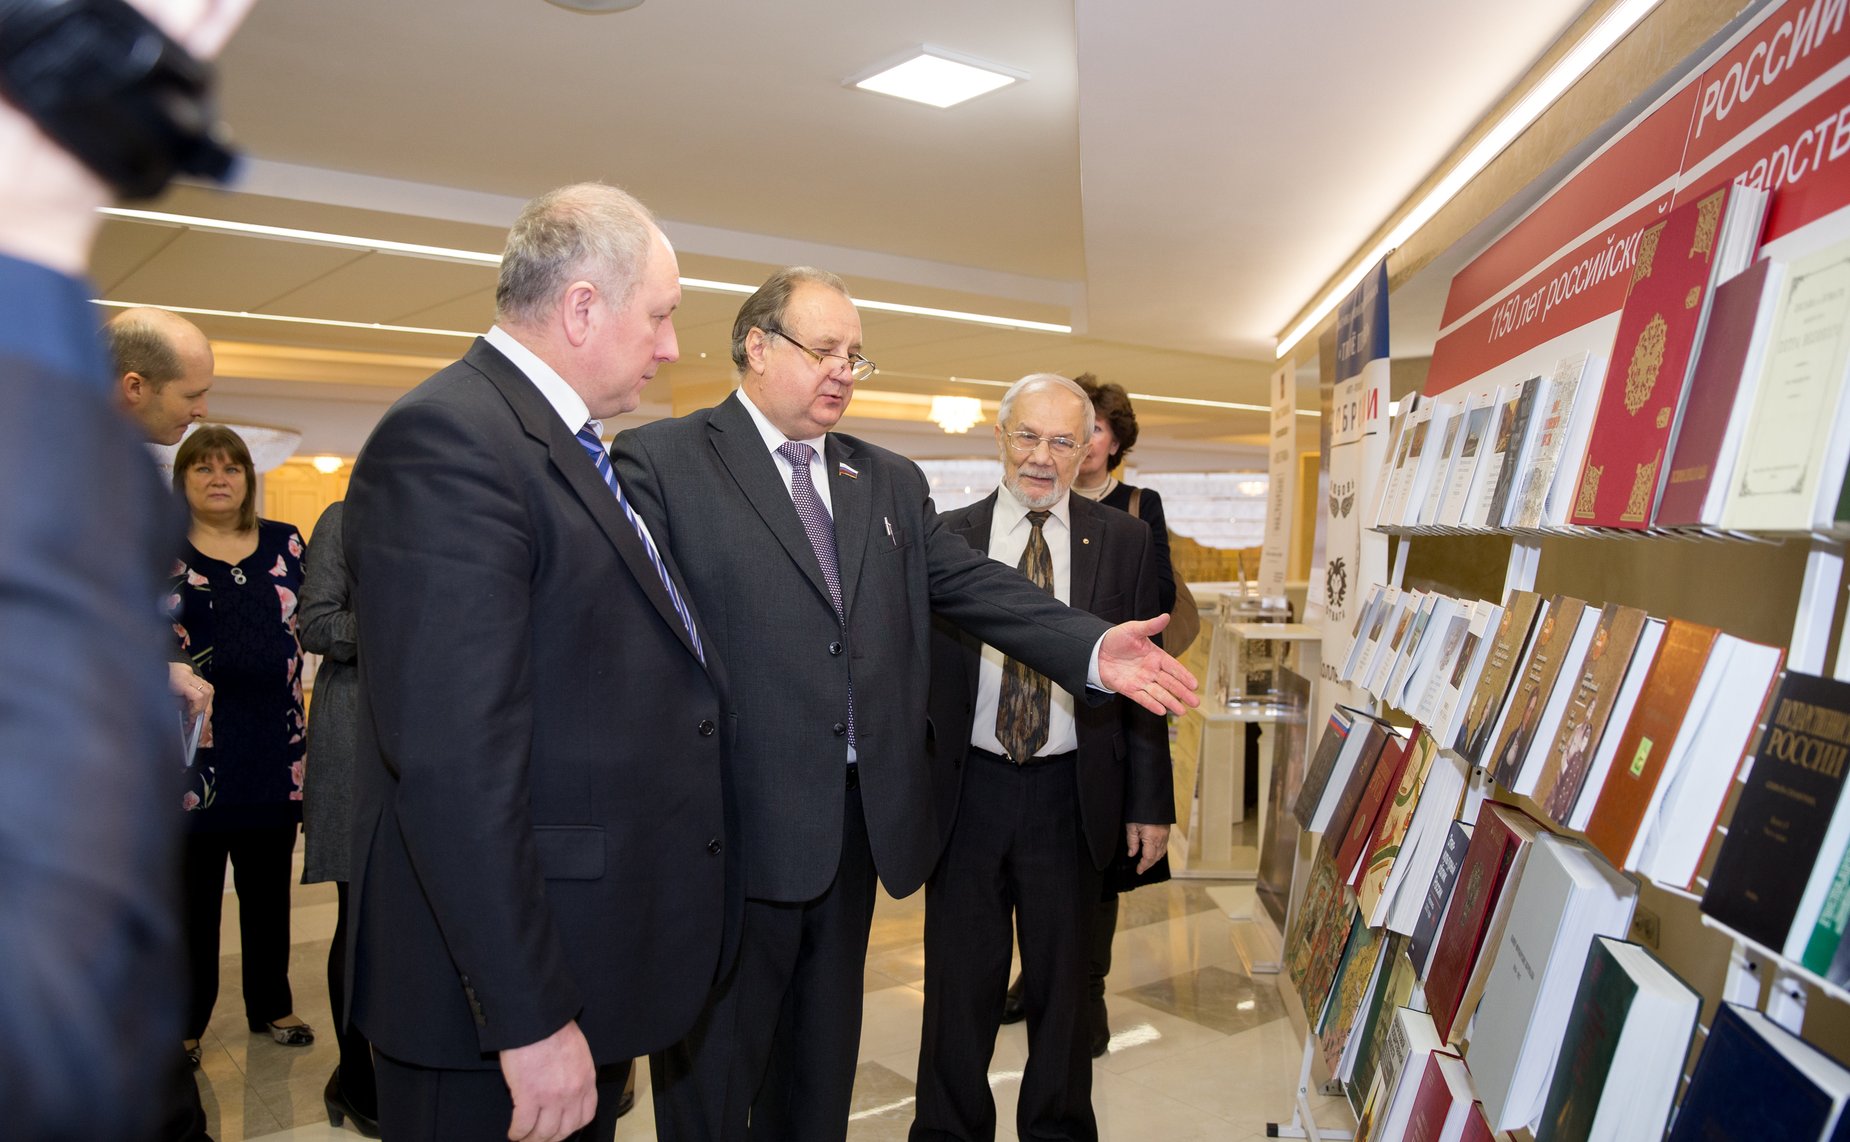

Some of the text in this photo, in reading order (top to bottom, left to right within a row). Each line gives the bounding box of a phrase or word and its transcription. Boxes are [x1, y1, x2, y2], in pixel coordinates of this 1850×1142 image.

[1488, 203, 1667, 343] 1150 лет российск
